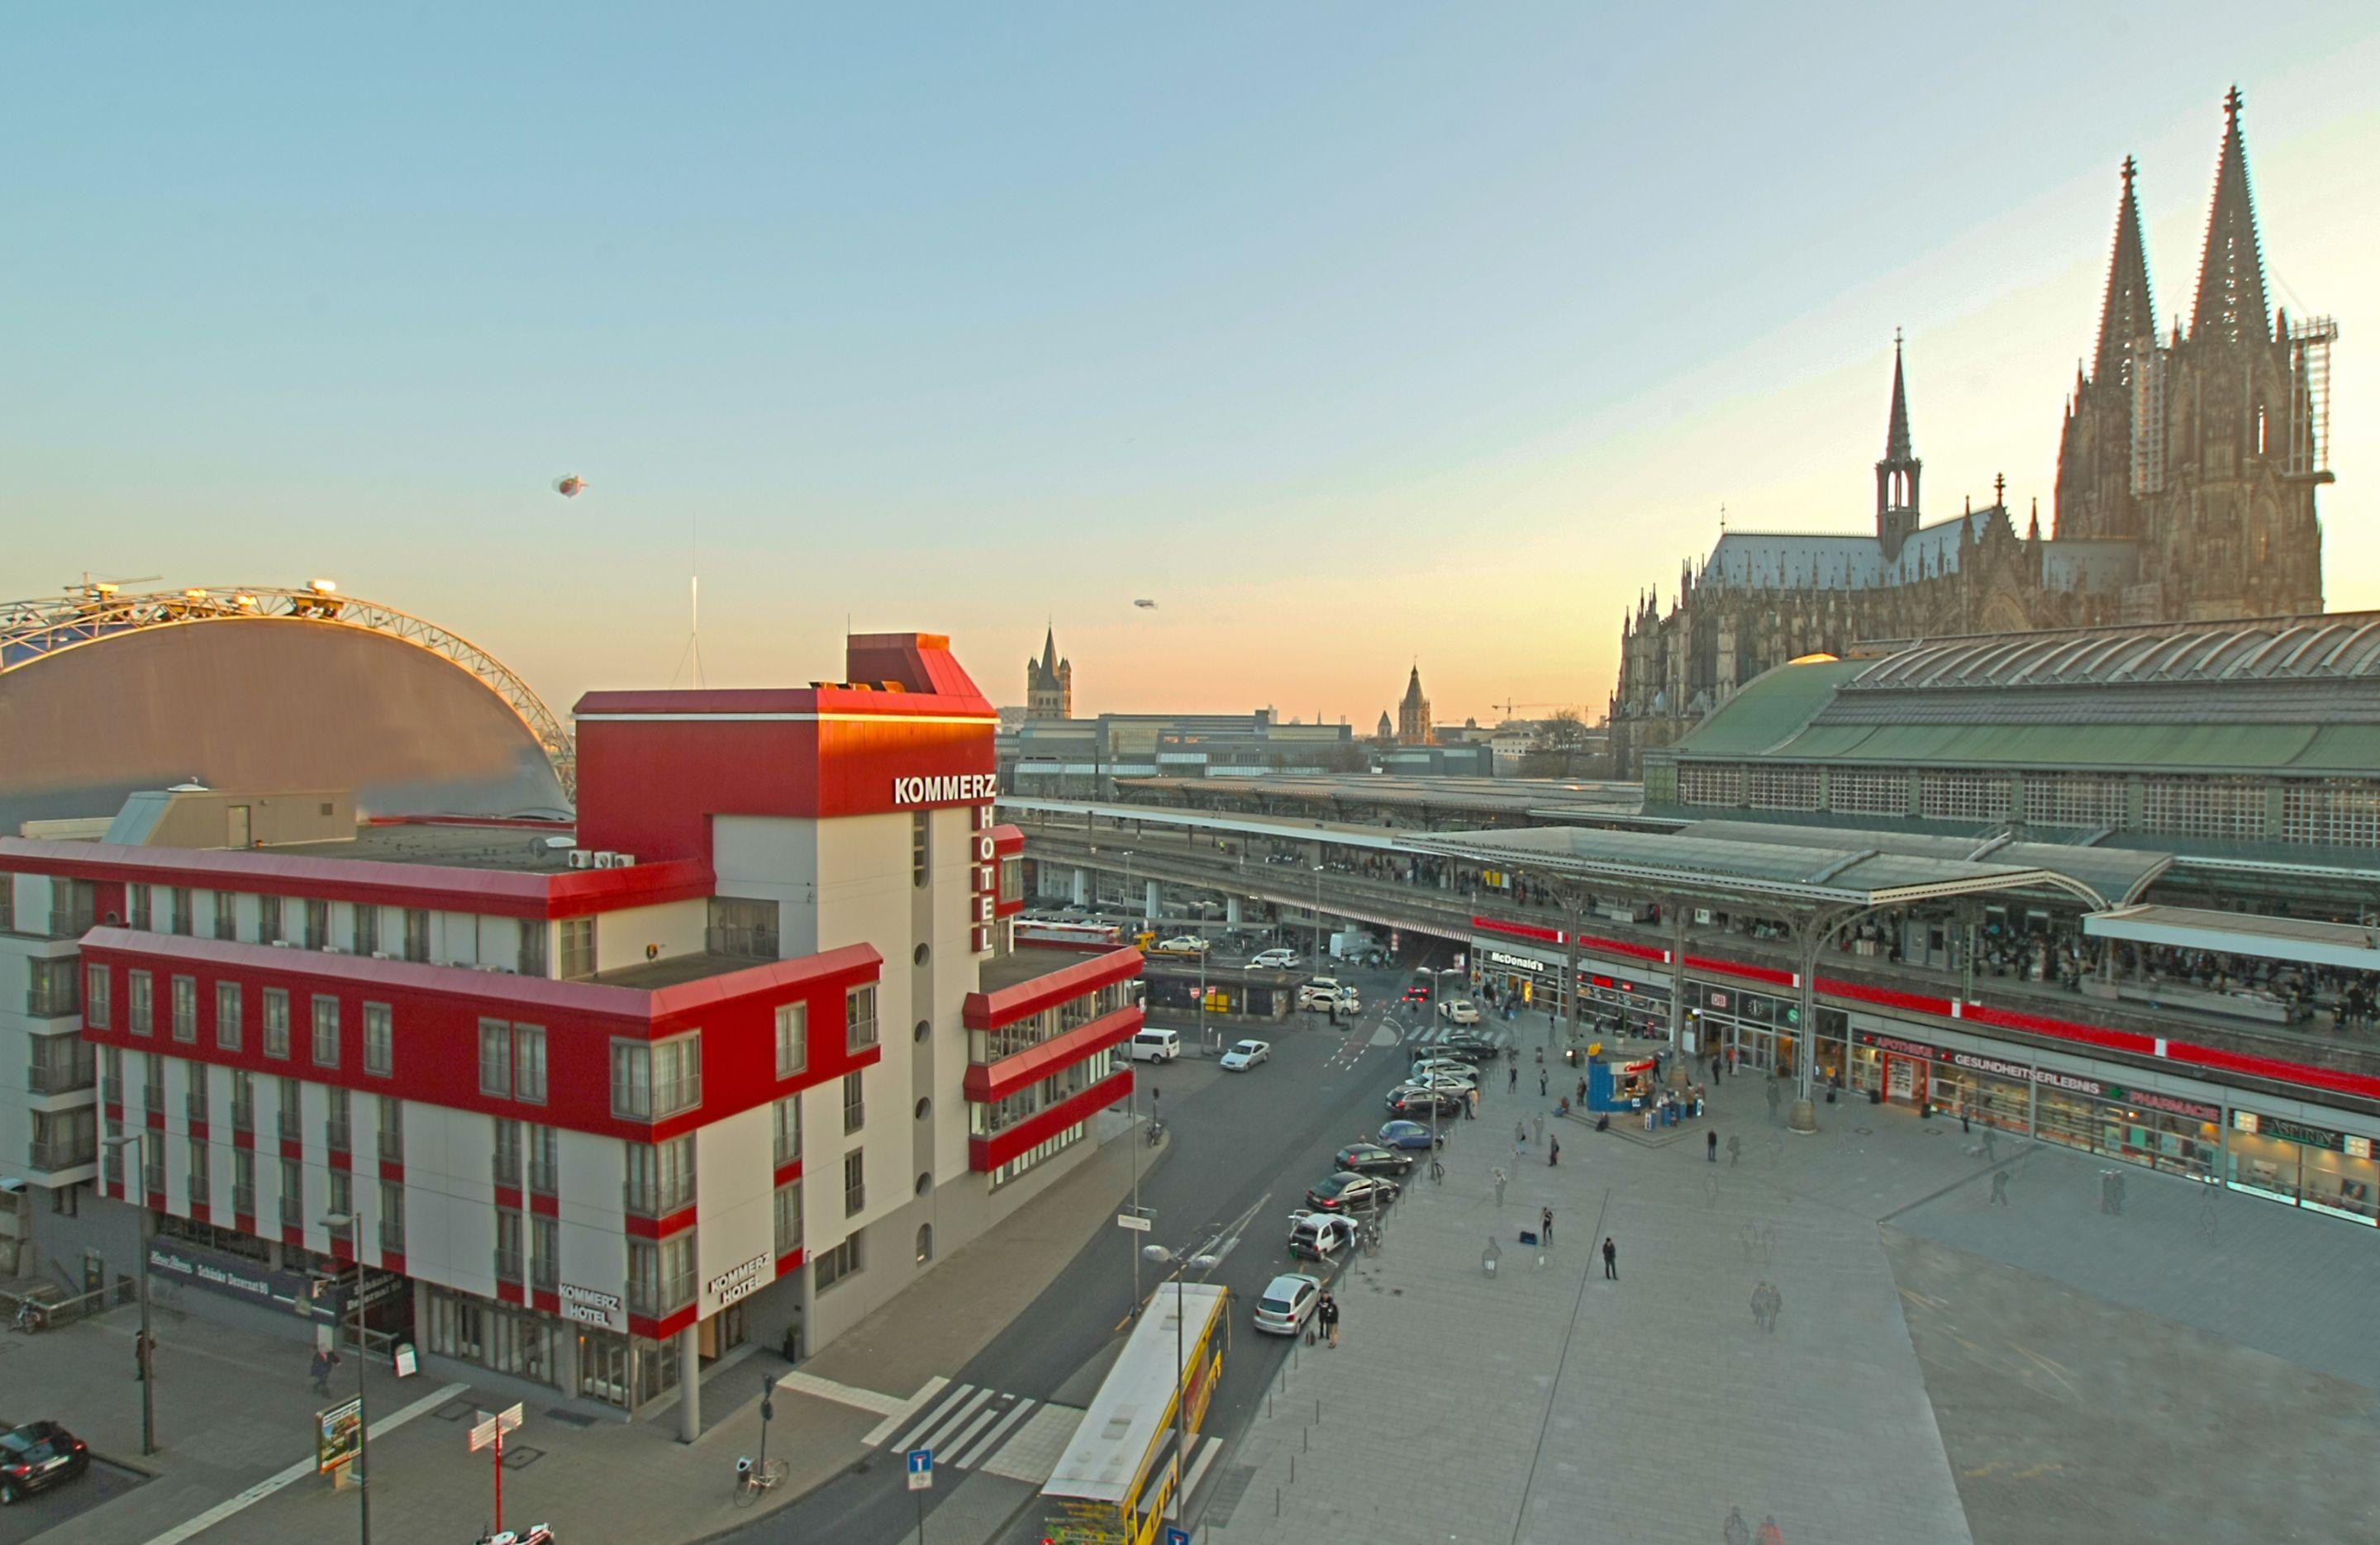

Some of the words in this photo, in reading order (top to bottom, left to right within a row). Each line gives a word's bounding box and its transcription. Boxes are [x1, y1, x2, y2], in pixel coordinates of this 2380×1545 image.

[894, 773, 997, 804] KOMMERZ
[980, 806, 994, 951] HOTEL
[1491, 951, 1544, 972] McDonald's
[1712, 995, 1726, 1006] DB
[1878, 1036, 1934, 1058] APOTHEKE
[1954, 1054, 2100, 1095] GESUNDHEITSERLEBNIS
[2130, 1091, 2220, 1122] PHARMACIE
[2272, 1119, 2332, 1146] ASPIRIN
[712, 1253, 770, 1295] KOMMERZ
[559, 1283, 618, 1311] KOMMERZ
[722, 1276, 762, 1305] HOTEL
[570, 1304, 610, 1326] HOTEL
